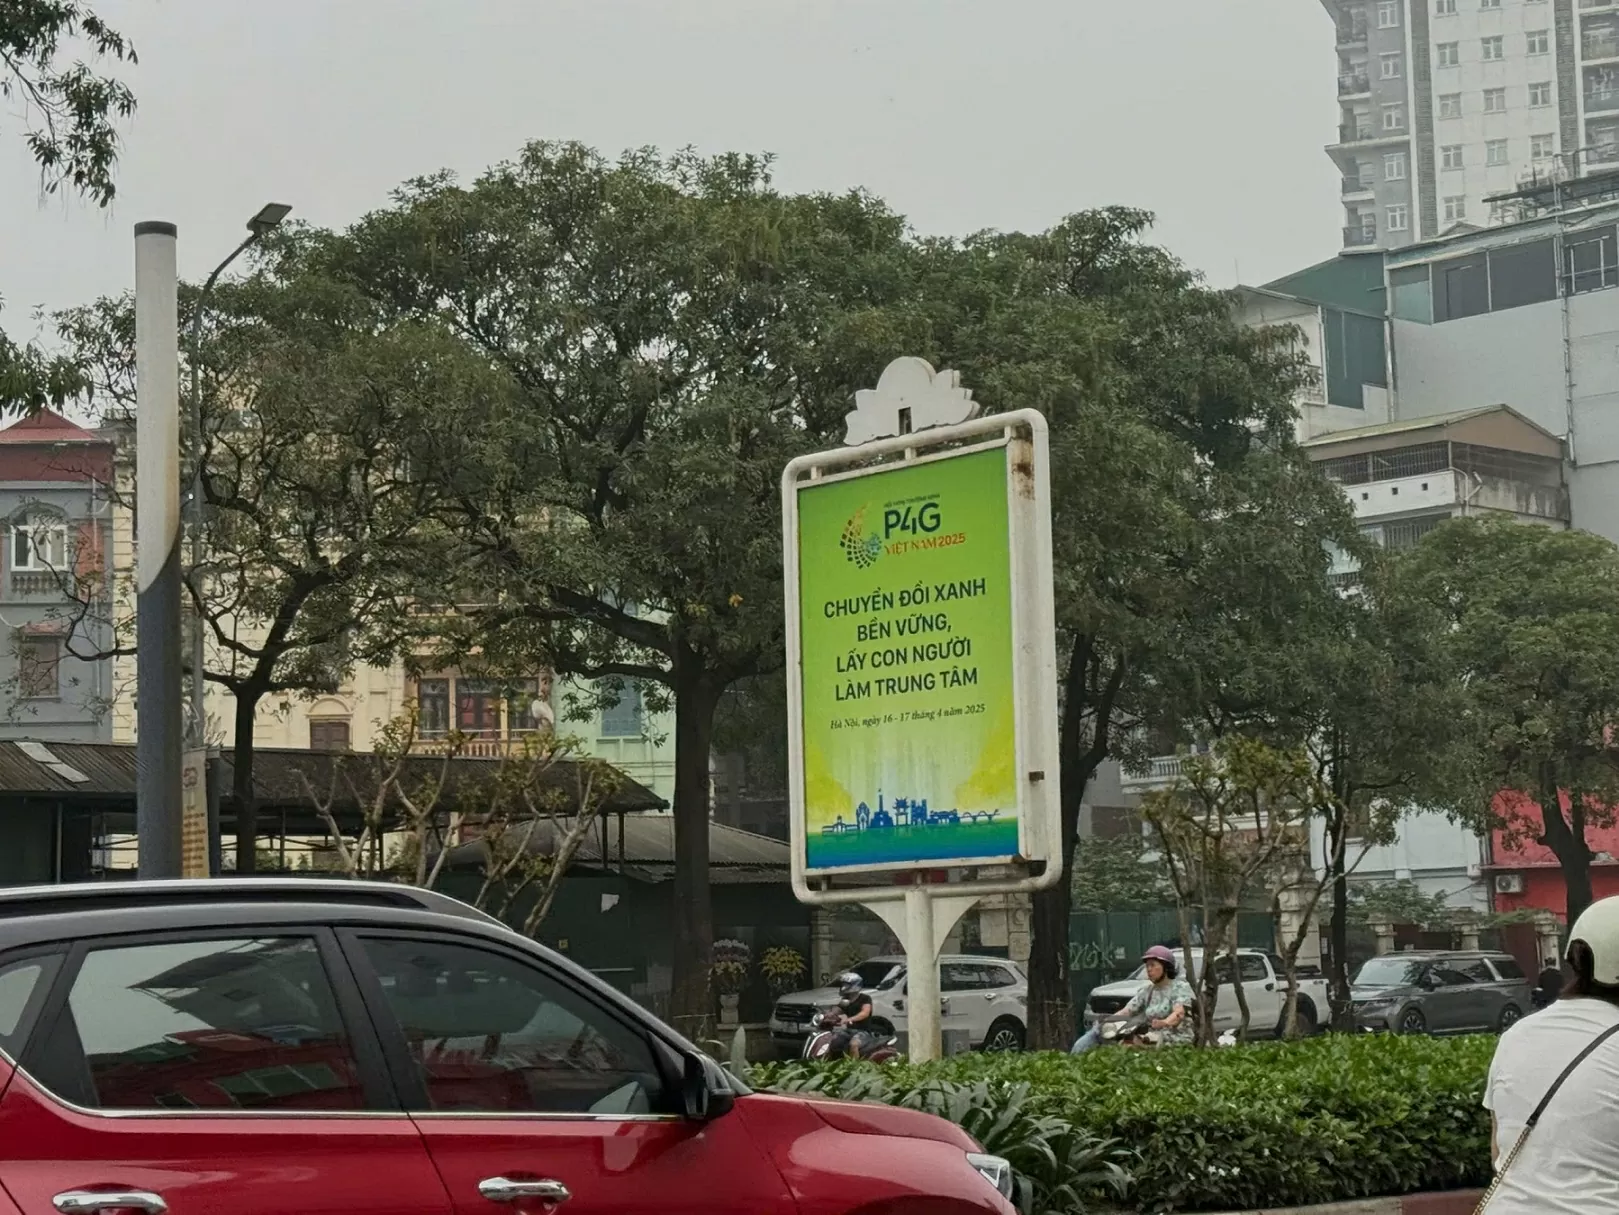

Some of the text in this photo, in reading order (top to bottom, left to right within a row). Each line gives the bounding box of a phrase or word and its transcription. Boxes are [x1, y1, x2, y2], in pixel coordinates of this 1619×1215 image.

[884, 502, 941, 539] P4G
[911, 536, 937, 550] NAM
[938, 532, 966, 547] 2025
[934, 578, 986, 602] XANH
[857, 613, 952, 642] BỀN VỮNG,
[836, 636, 971, 673] LẤY CON NGƯỜI
[835, 665, 978, 701] LÀM TRUNG TÂM
[883, 714, 893, 724] 16
[900, 711, 911, 722] 17
[937, 708, 942, 718] 4
[964, 703, 986, 715] 2025
